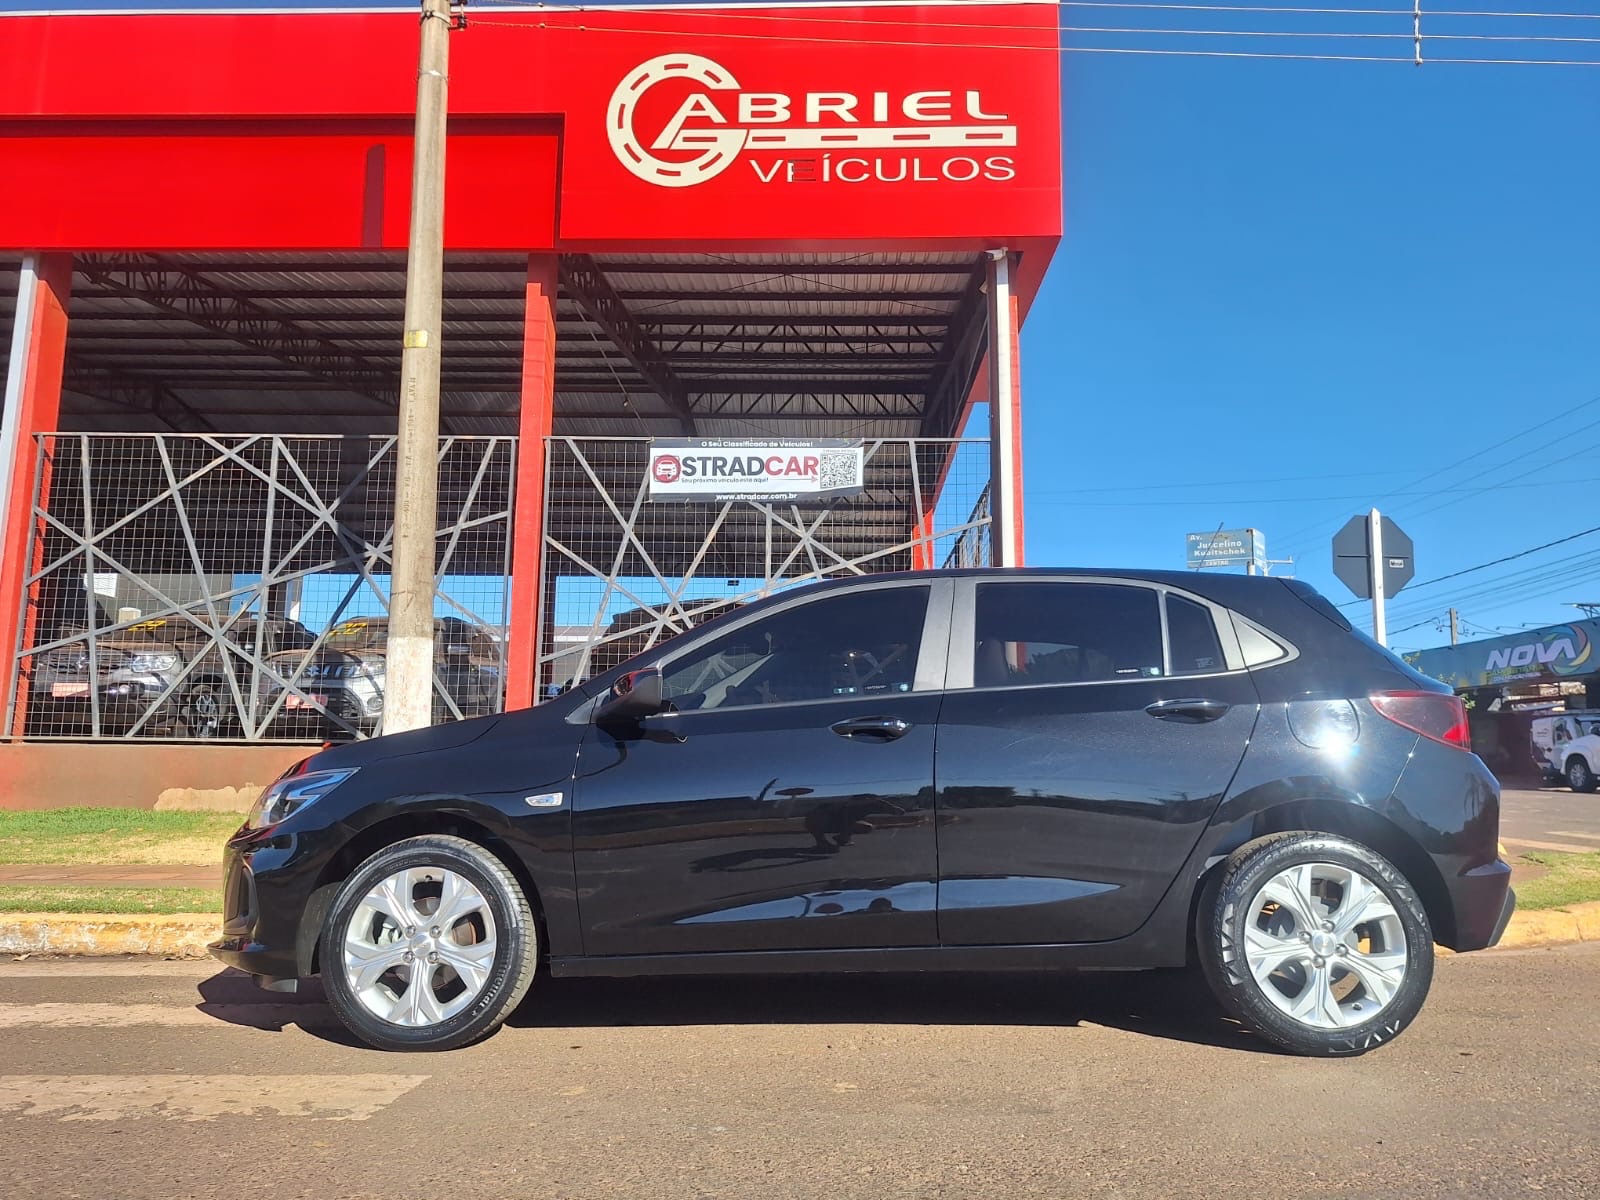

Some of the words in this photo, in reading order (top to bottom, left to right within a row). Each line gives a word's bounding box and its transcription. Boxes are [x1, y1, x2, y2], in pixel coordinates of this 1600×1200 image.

[749, 153, 1016, 184] VEÍCULOS
[681, 456, 819, 476] STRADCAR
[1486, 638, 1576, 669] NOVA
